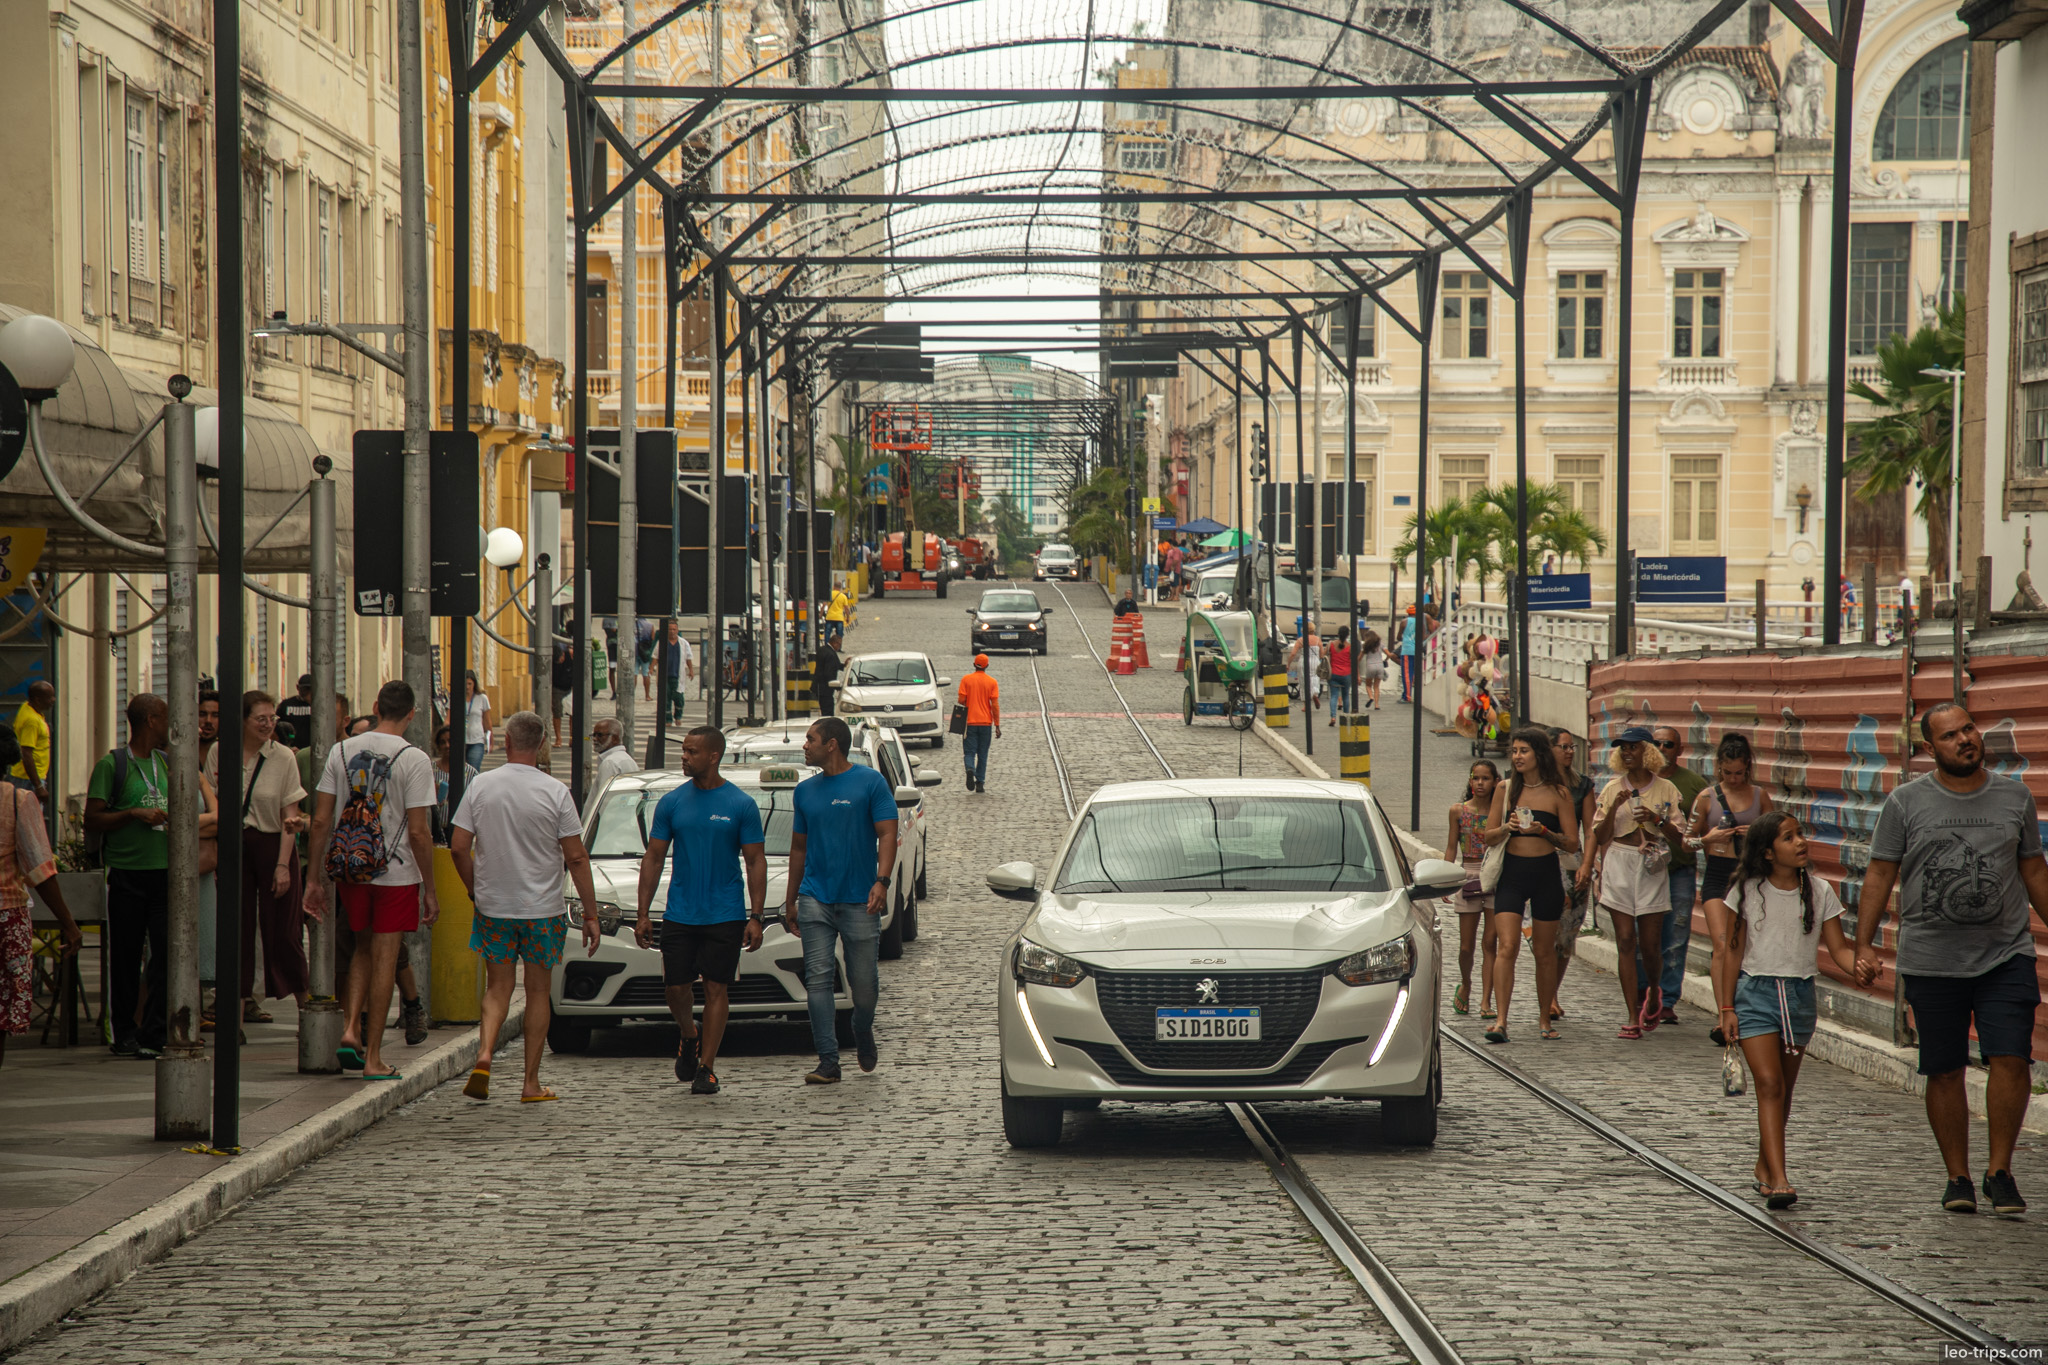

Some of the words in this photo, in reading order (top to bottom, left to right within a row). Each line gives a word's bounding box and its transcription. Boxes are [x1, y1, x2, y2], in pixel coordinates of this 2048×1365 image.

[1641, 562, 1668, 571] Ladeira
[1641, 573, 1651, 581] da
[1653, 573, 1701, 581] Misericórdia
[768, 769, 794, 780] TAXI
[1166, 1019, 1249, 1038] SID1B00
